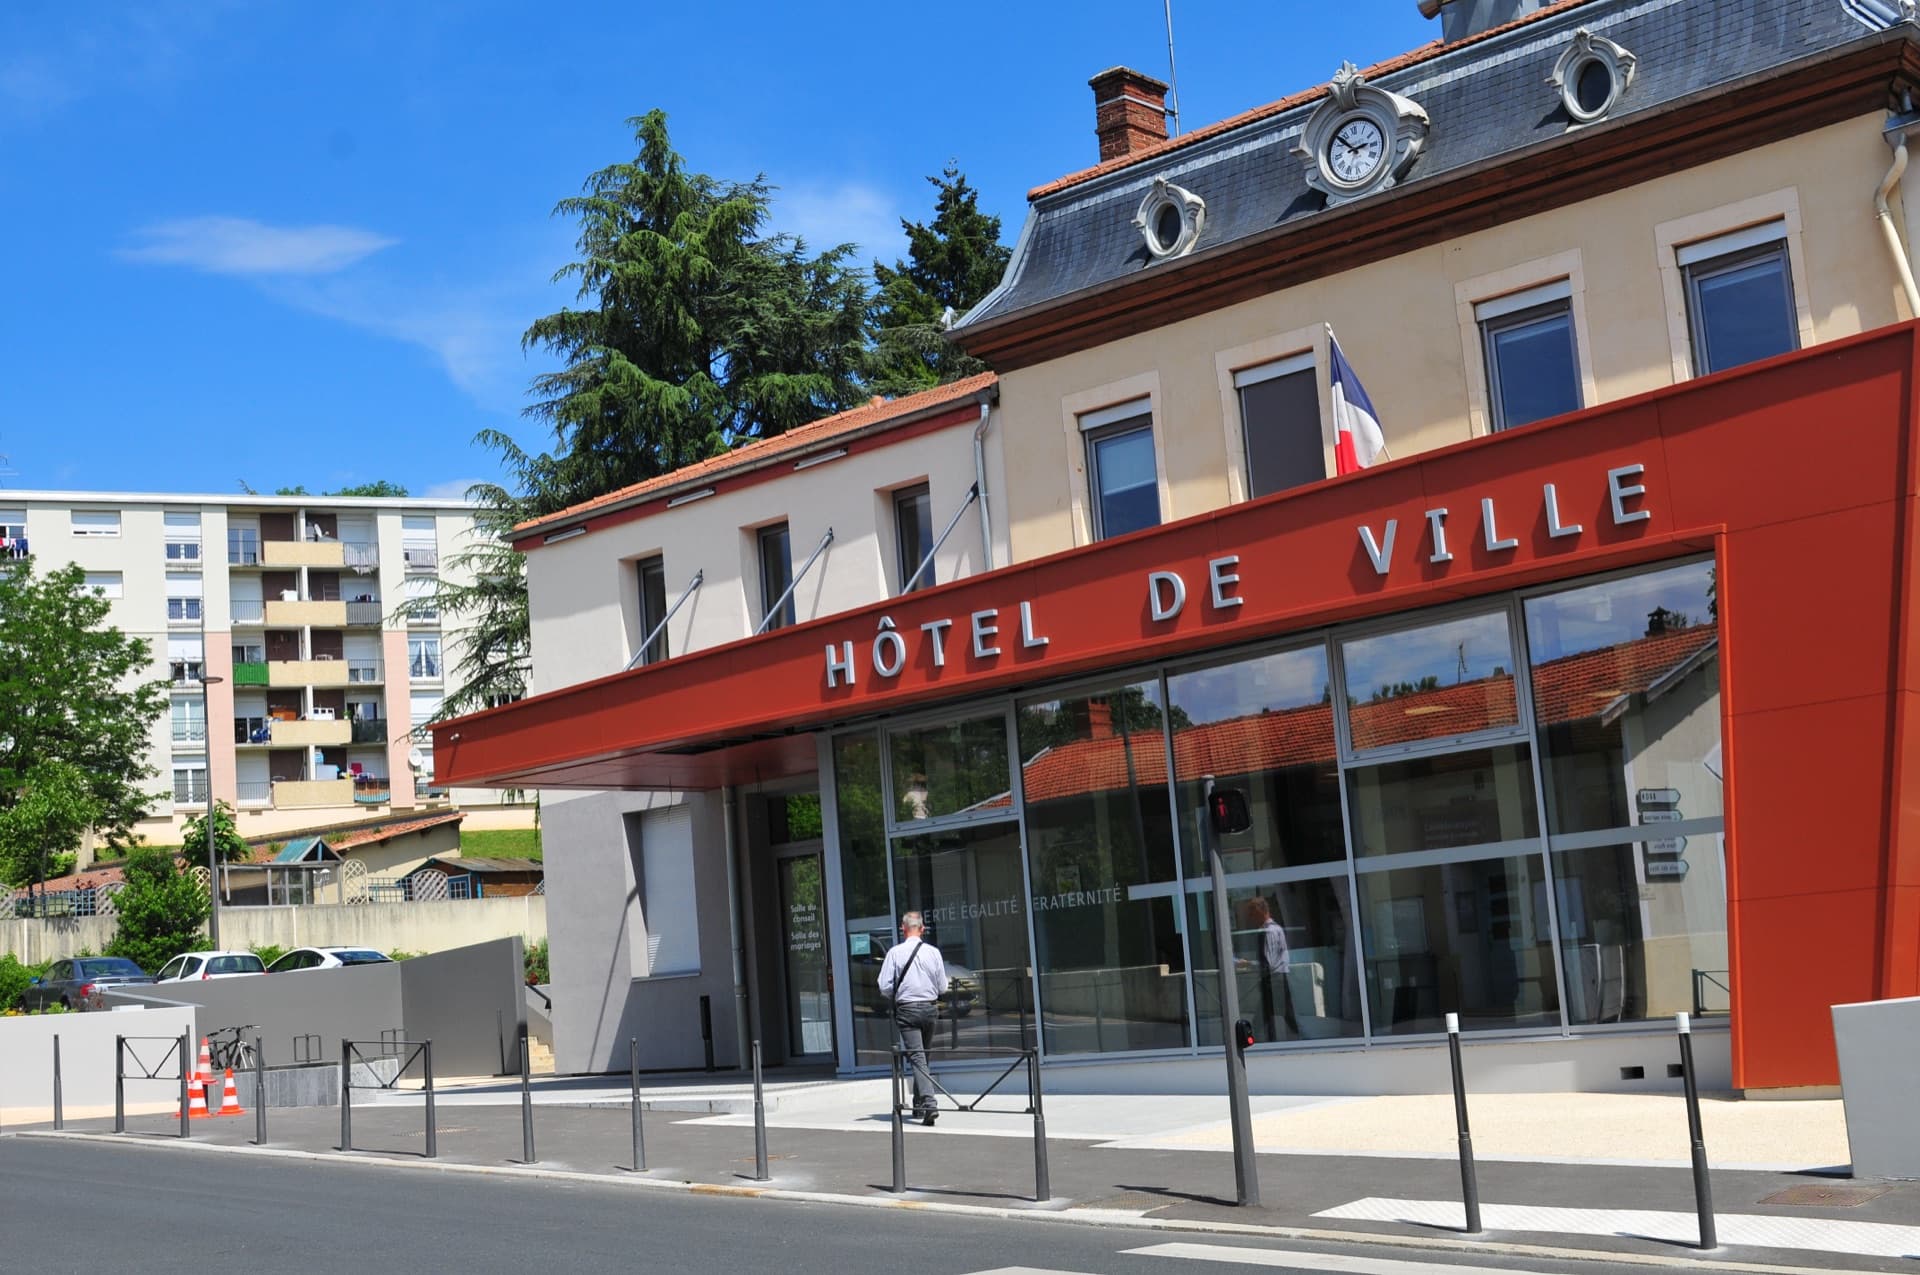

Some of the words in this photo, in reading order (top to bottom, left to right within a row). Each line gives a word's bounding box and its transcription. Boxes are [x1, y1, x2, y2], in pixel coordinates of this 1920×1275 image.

[825, 600, 1049, 688] HÔTEL
[1148, 555, 1244, 621] DE
[1357, 463, 1651, 575] VILLE
[790, 903, 806, 913] Salle
[807, 903, 817, 911] du
[960, 894, 1018, 919] ÉGALITÉ
[792, 912, 815, 922] conseil
[791, 931, 806, 941] Salle
[807, 929, 819, 938] des
[790, 940, 821, 952] mariages
